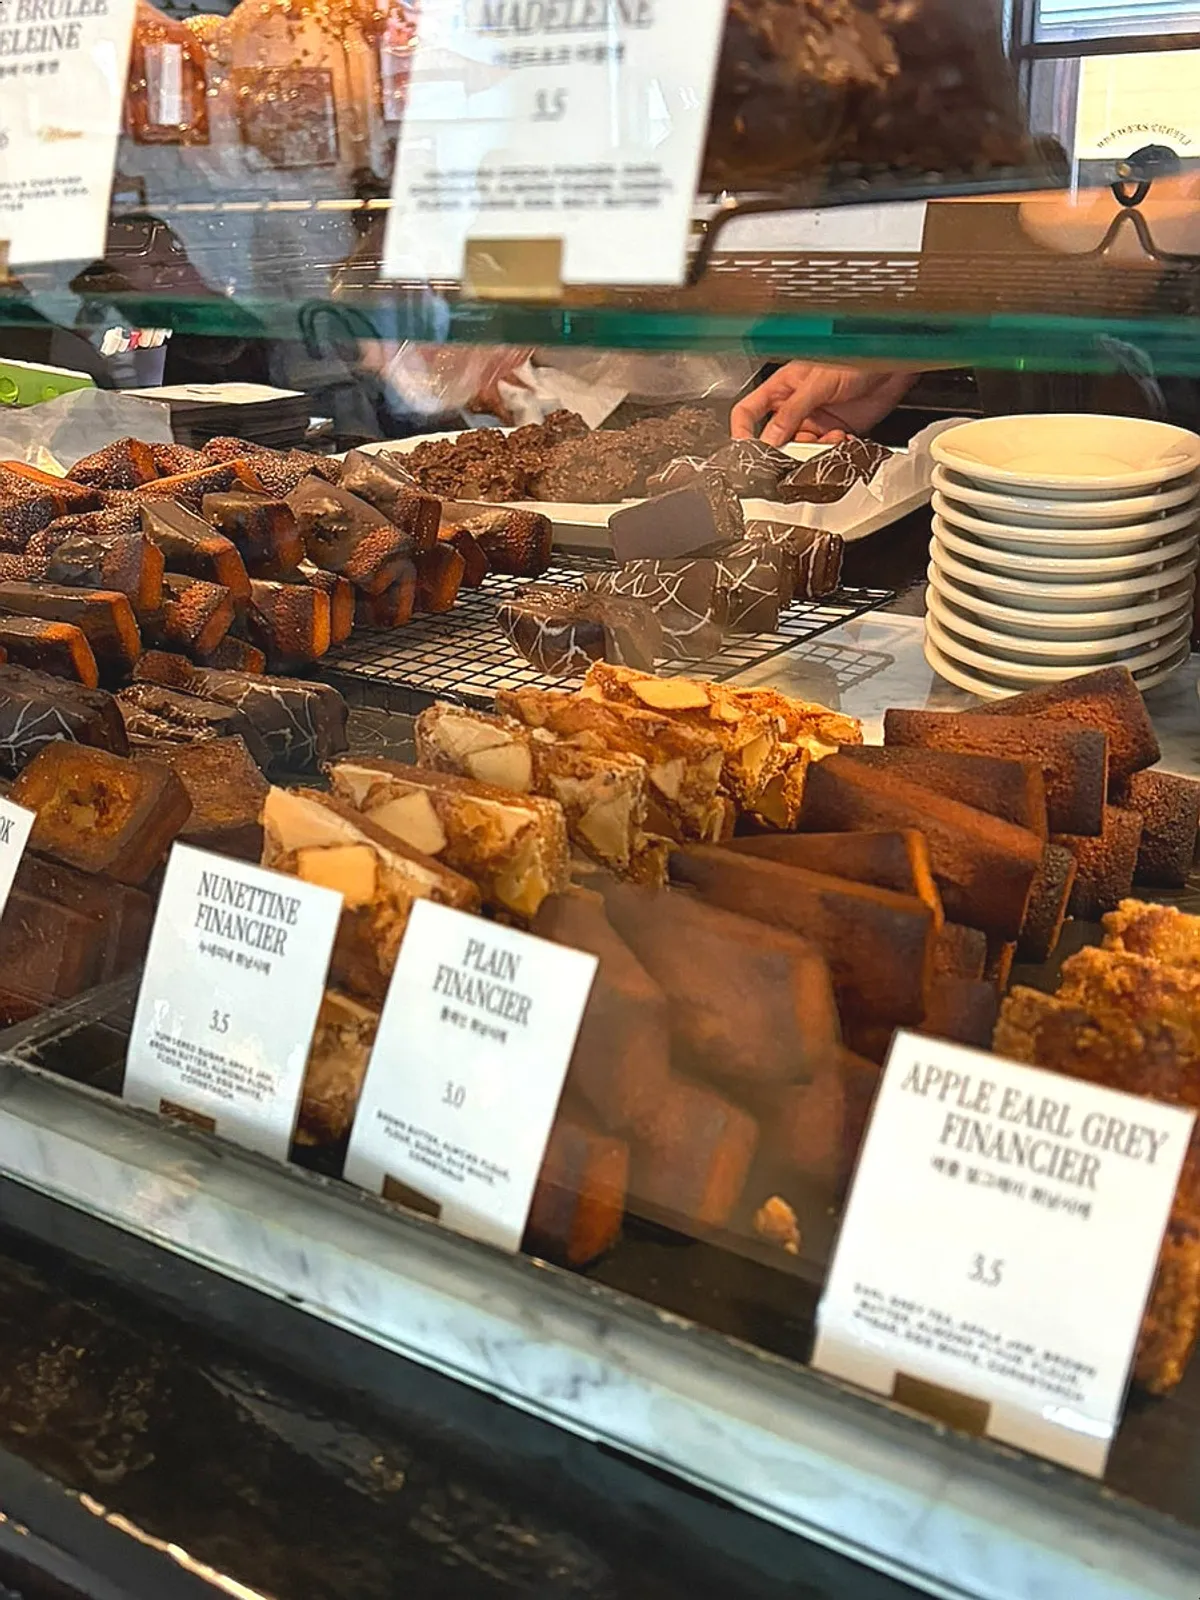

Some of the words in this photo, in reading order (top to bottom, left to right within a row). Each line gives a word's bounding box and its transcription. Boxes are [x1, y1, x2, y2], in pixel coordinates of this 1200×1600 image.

[197, 871, 302, 926] NUNETTINE
[194, 903, 288, 957] FINANCIER
[462, 937, 522, 983] PLAIN
[208, 1009, 231, 1034] 3.5
[432, 963, 533, 1028] FINANCIER
[441, 1080, 466, 1109] 3.0
[901, 1061, 997, 1115] APPLE
[996, 1086, 1074, 1139] EARL
[1080, 1111, 1170, 1164] GREY
[939, 1111, 1101, 1191] FINANCIER
[967, 1252, 1006, 1287] 3.5
